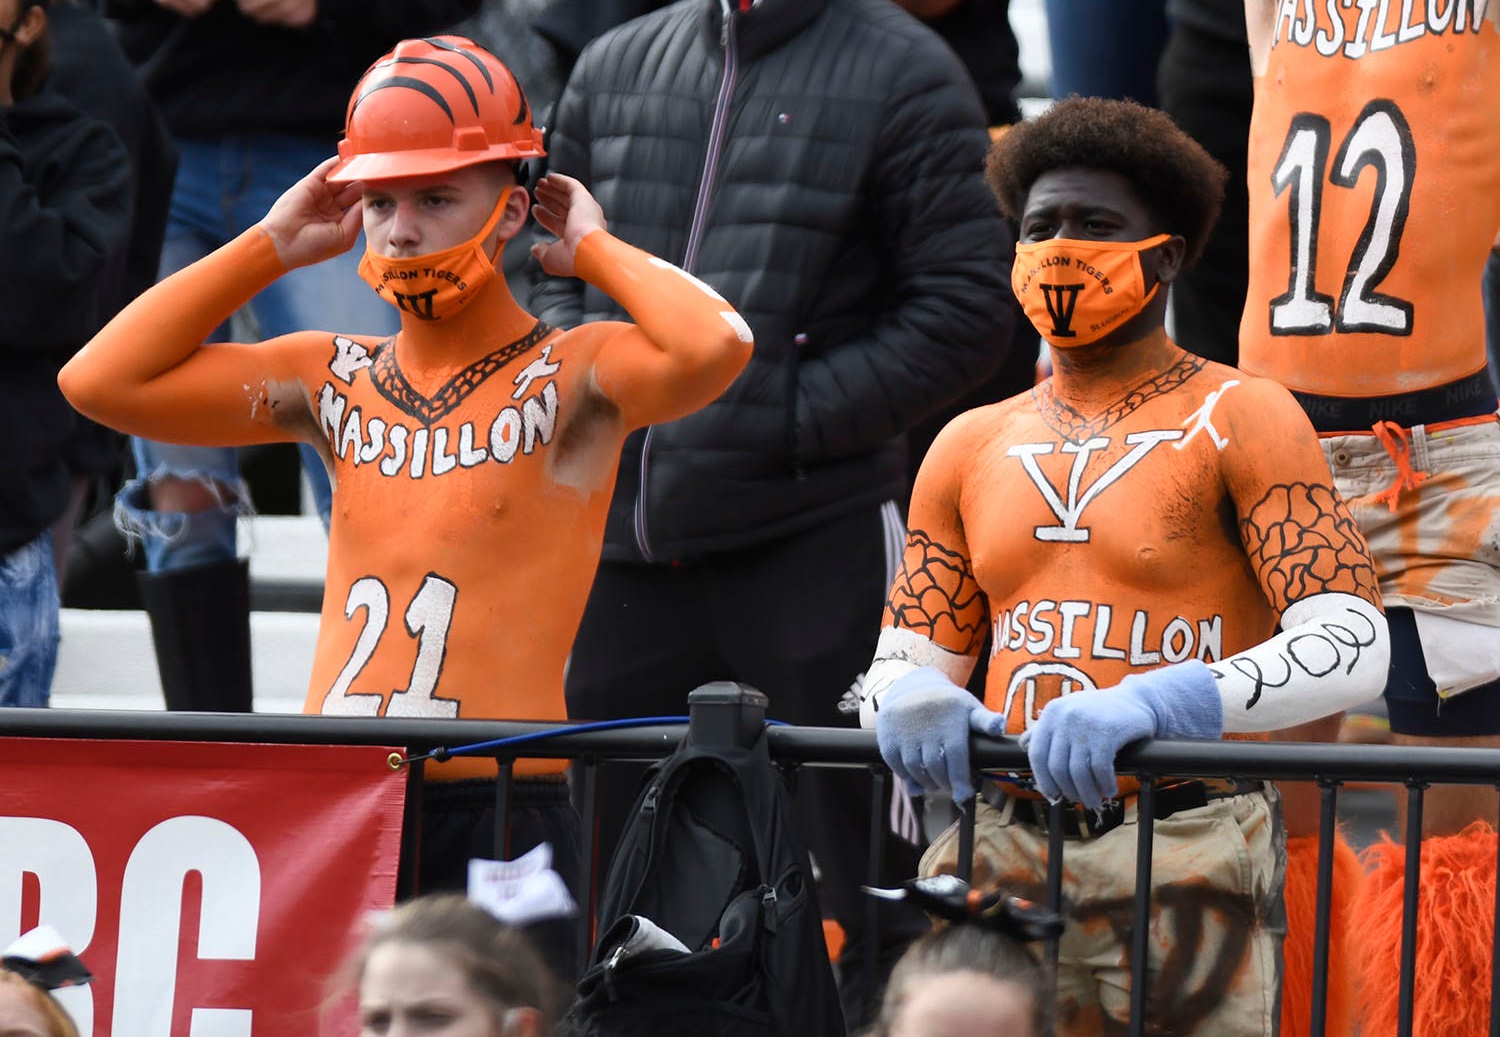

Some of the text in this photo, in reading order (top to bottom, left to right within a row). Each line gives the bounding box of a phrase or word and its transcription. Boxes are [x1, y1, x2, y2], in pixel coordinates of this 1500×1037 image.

[1269, 97, 1417, 337] 12
[423, 267, 467, 291] TIGERS
[1075, 258, 1114, 296] TIGERS
[317, 379, 561, 480] MASSILLON
[1368, 397, 1418, 419] NIKE
[1445, 377, 1483, 405] NIKE
[320, 571, 461, 718] 21
